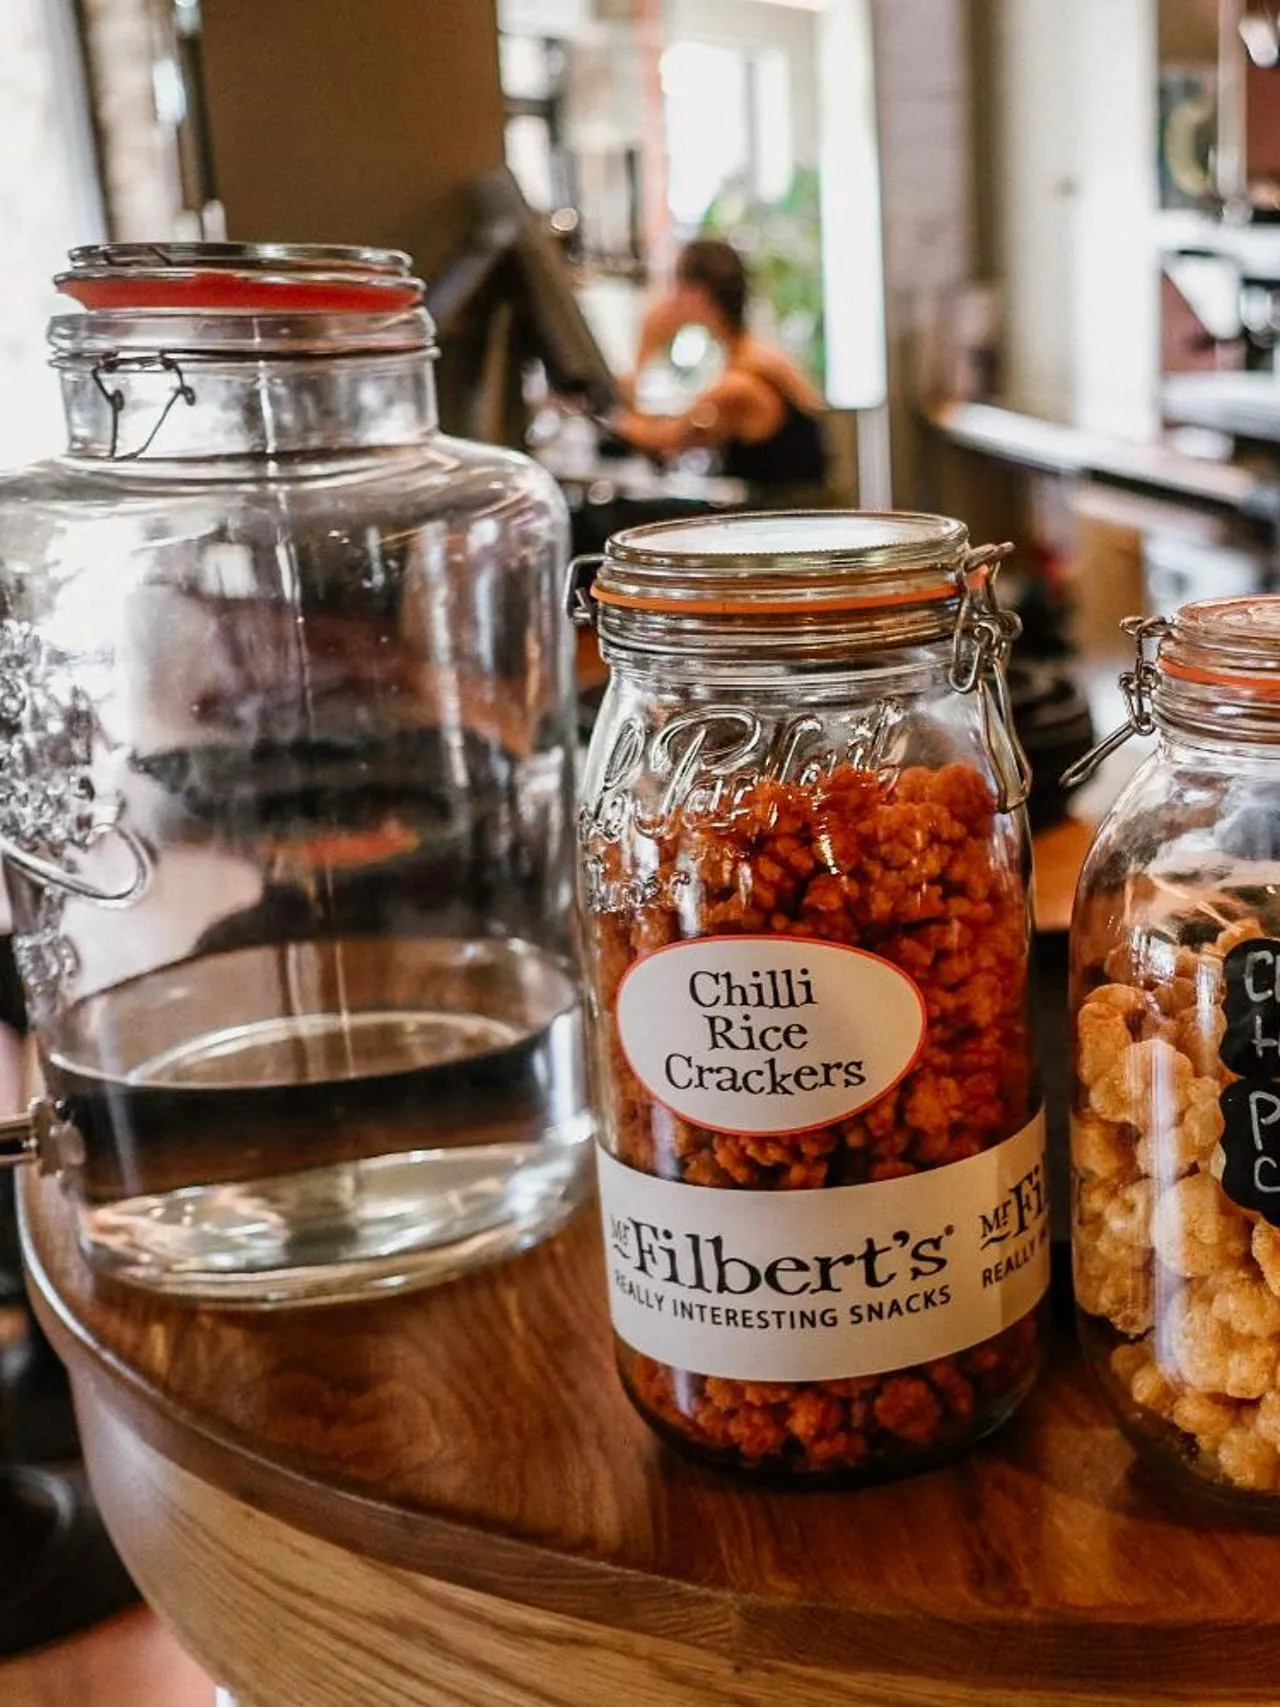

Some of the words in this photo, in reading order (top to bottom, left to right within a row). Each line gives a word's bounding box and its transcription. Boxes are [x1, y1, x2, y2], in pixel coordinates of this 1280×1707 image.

[689, 968, 818, 1009] Chilli
[704, 1014, 808, 1052] Rice
[664, 1053, 866, 1095] Crackers
[628, 1217, 949, 1296] Filbert's
[672, 1299, 838, 1330] INTERESTING
[850, 1285, 952, 1323] SNACKS
